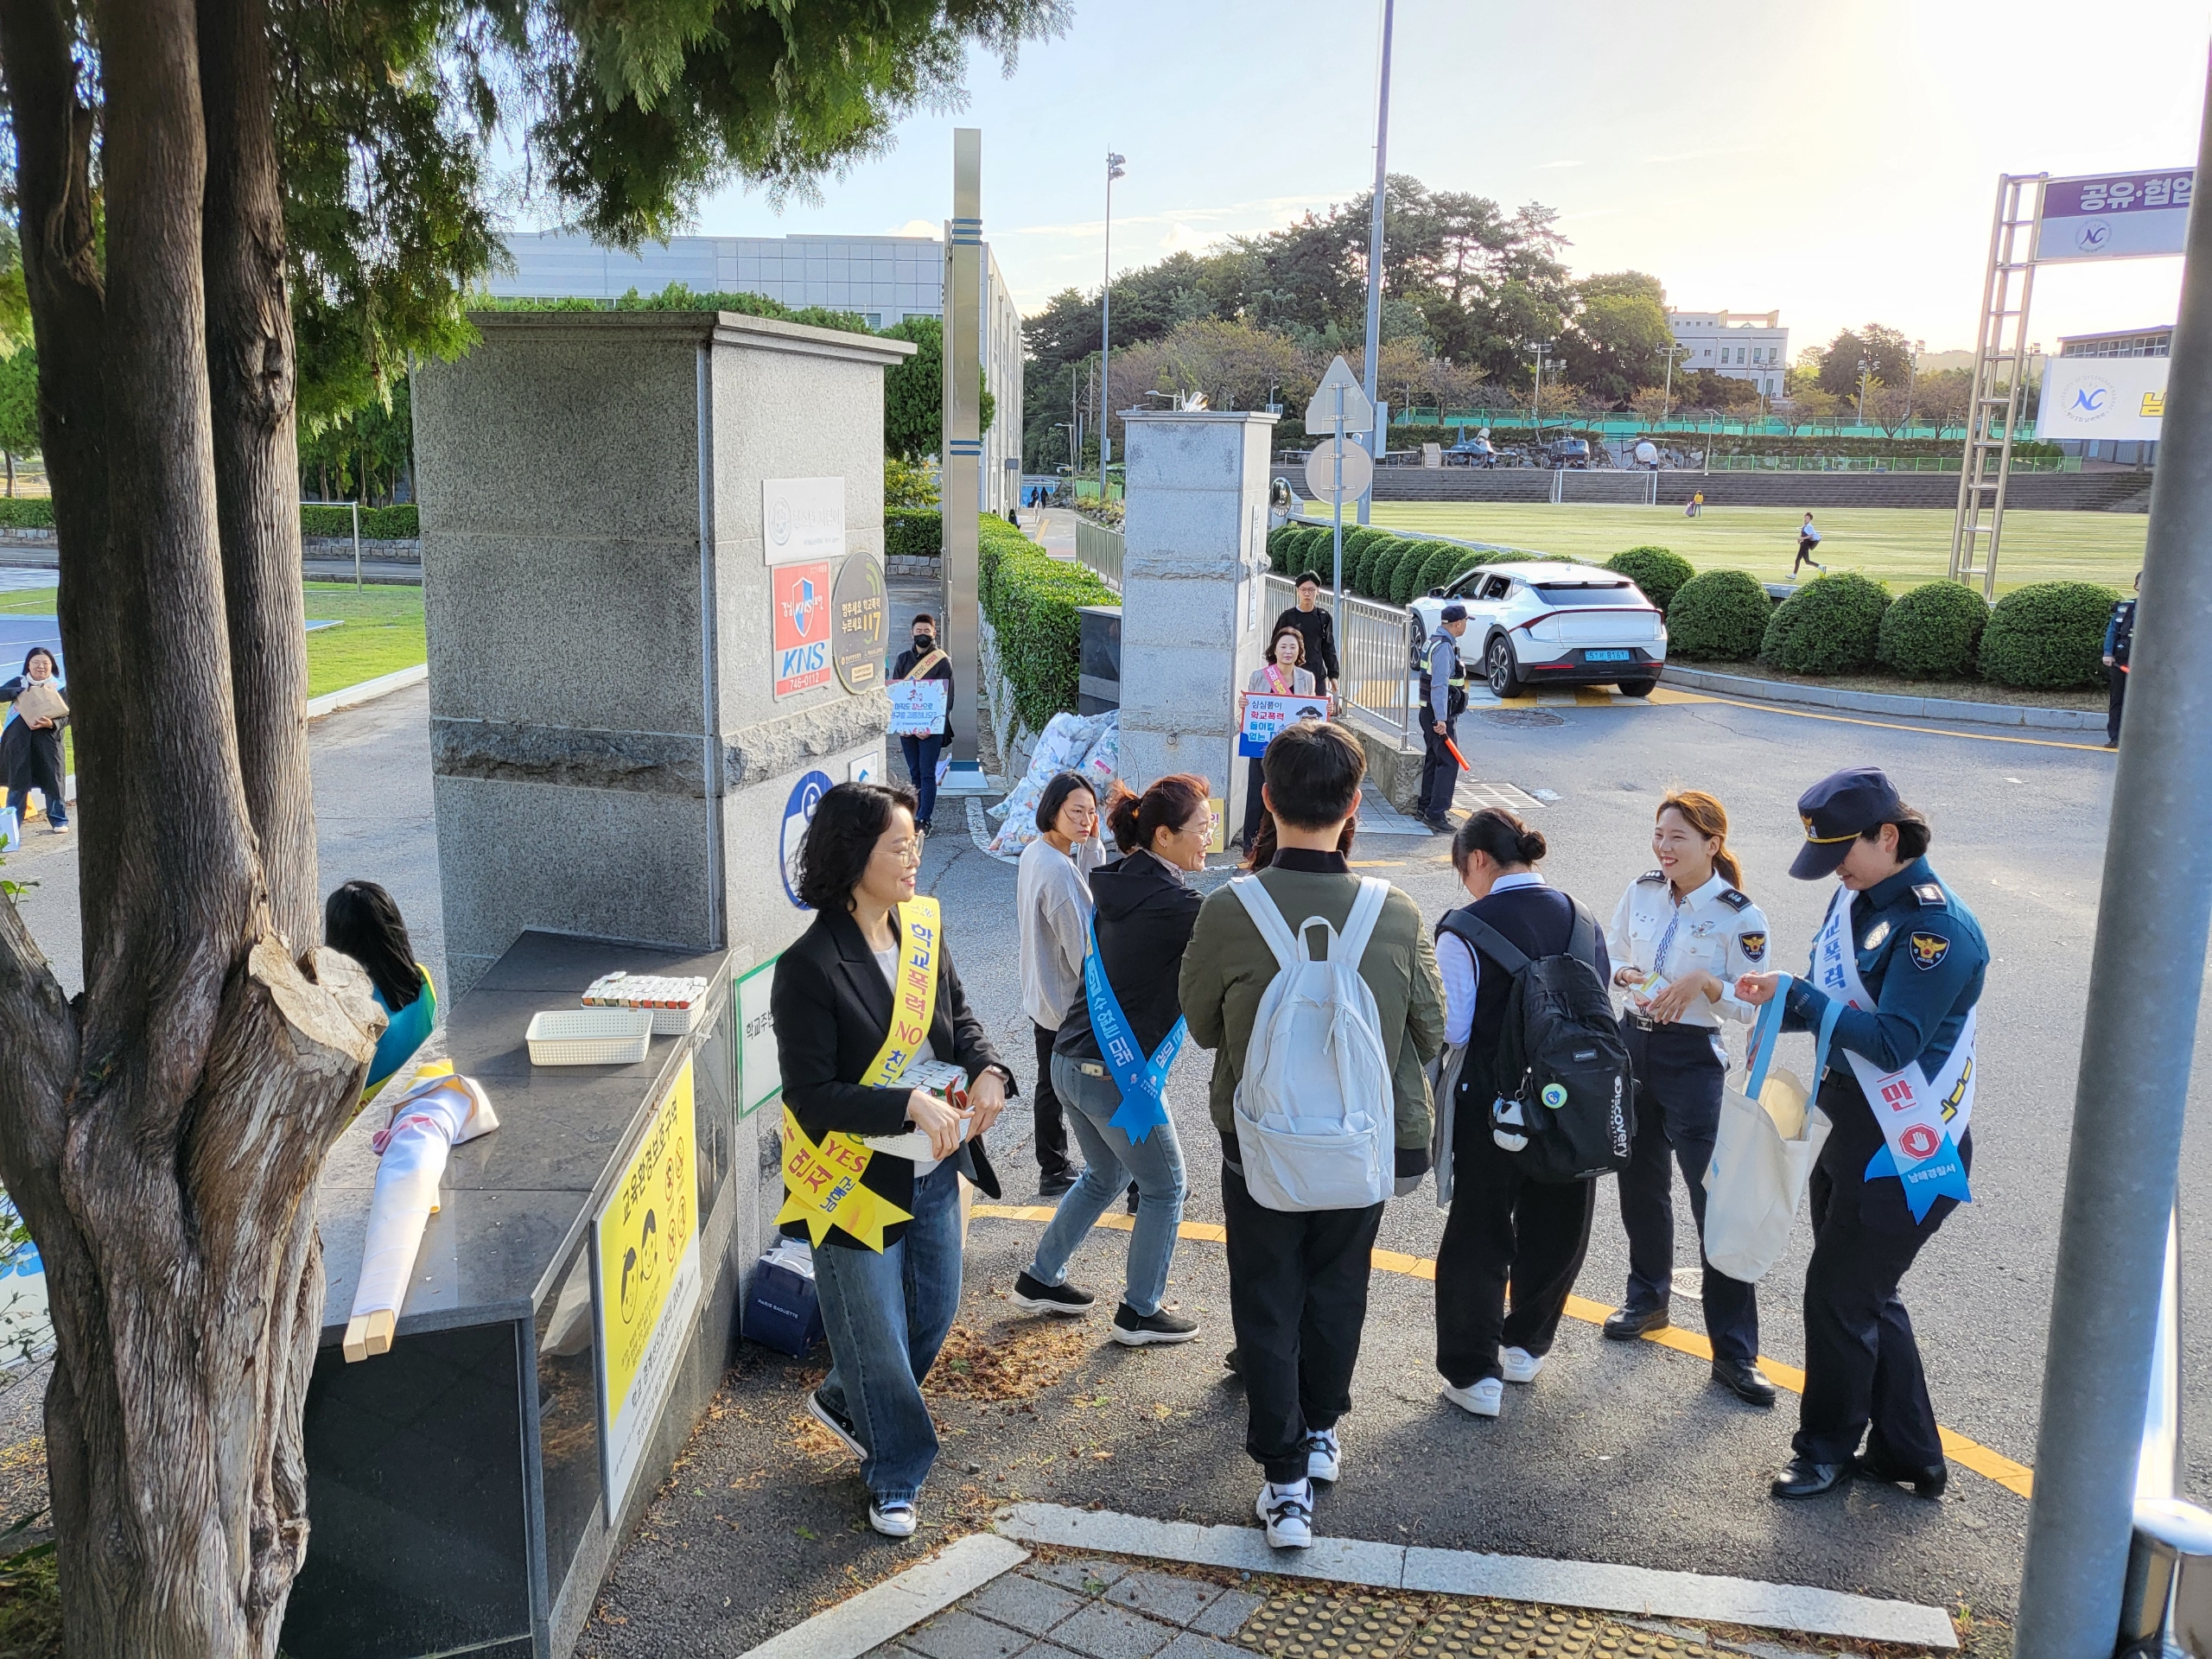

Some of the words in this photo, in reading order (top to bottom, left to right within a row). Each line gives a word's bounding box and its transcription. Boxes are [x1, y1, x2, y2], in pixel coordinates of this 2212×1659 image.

[781, 601, 793, 618] 경남
[795, 600, 813, 614] KNS
[814, 594, 823, 610] 보안
[842, 601, 862, 618] 멈추세요
[863, 597, 881, 612] 학교폭력
[842, 617, 862, 634] 누르세요
[863, 612, 881, 641] 117
[782, 642, 825, 677] KNS
[790, 671, 820, 690] 746-0112
[1250, 711, 1285, 721] 학교폭력
[895, 1020, 923, 1046] NO
[1876, 1071, 1916, 1112] 만
[622, 1096, 678, 1227] 교육환경보호구역
[823, 1139, 868, 1173] YES
[1907, 1163, 1957, 1185] 남해경찰서
[819, 1175, 857, 1213] 남해군
[758, 1299, 772, 1308] PARIS
[772, 1305, 798, 1319] BAGUETTE
[631, 1382, 643, 1409] 학교
